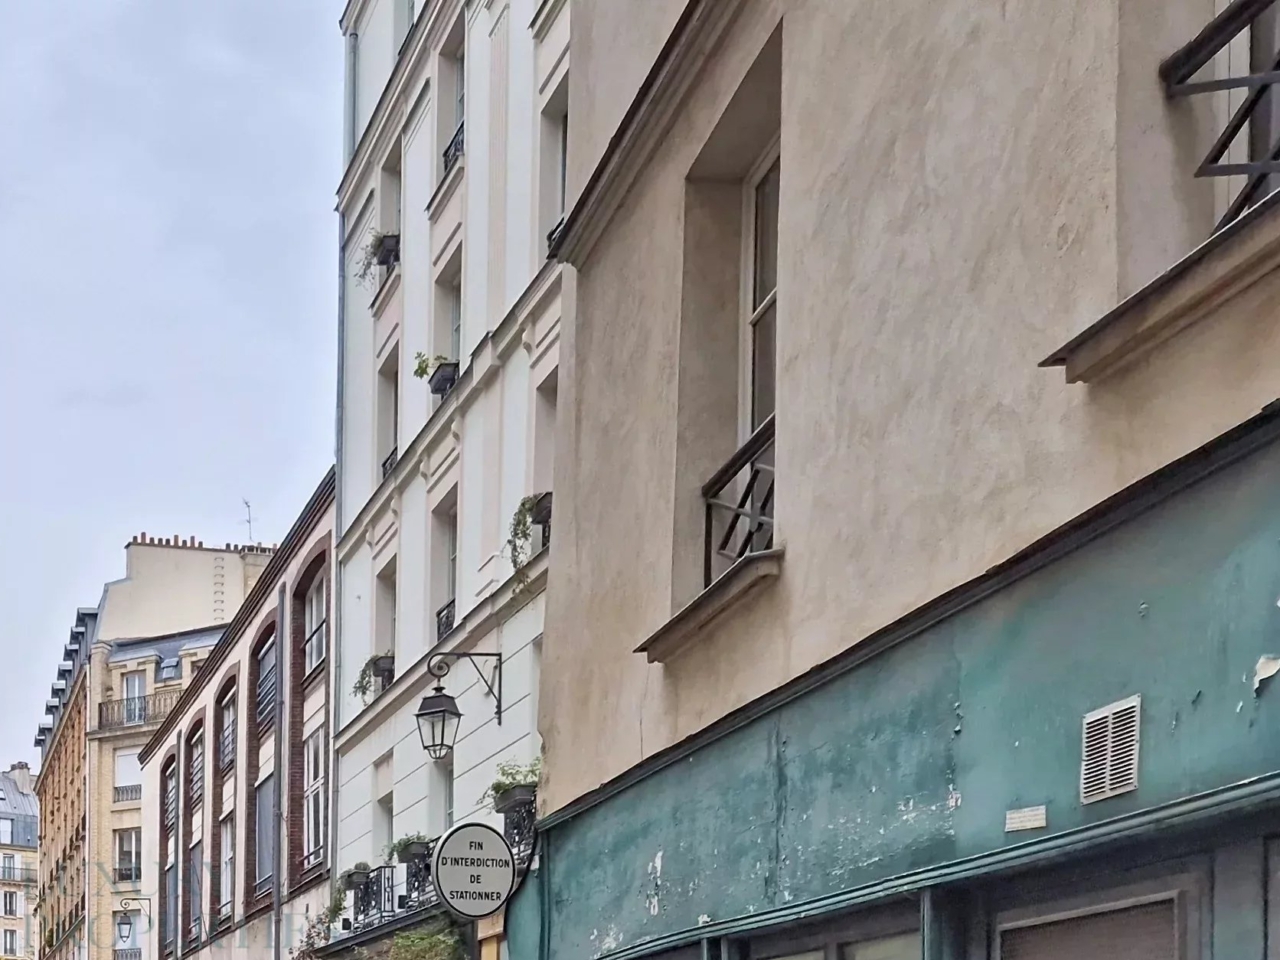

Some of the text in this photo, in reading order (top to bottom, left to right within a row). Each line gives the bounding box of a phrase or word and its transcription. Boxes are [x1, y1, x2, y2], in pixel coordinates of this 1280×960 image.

[469, 841, 483, 850] FIN
[442, 857, 510, 868] D'INTERDICTION
[469, 874, 482, 884] DE
[449, 890, 502, 901] STATIONNER
